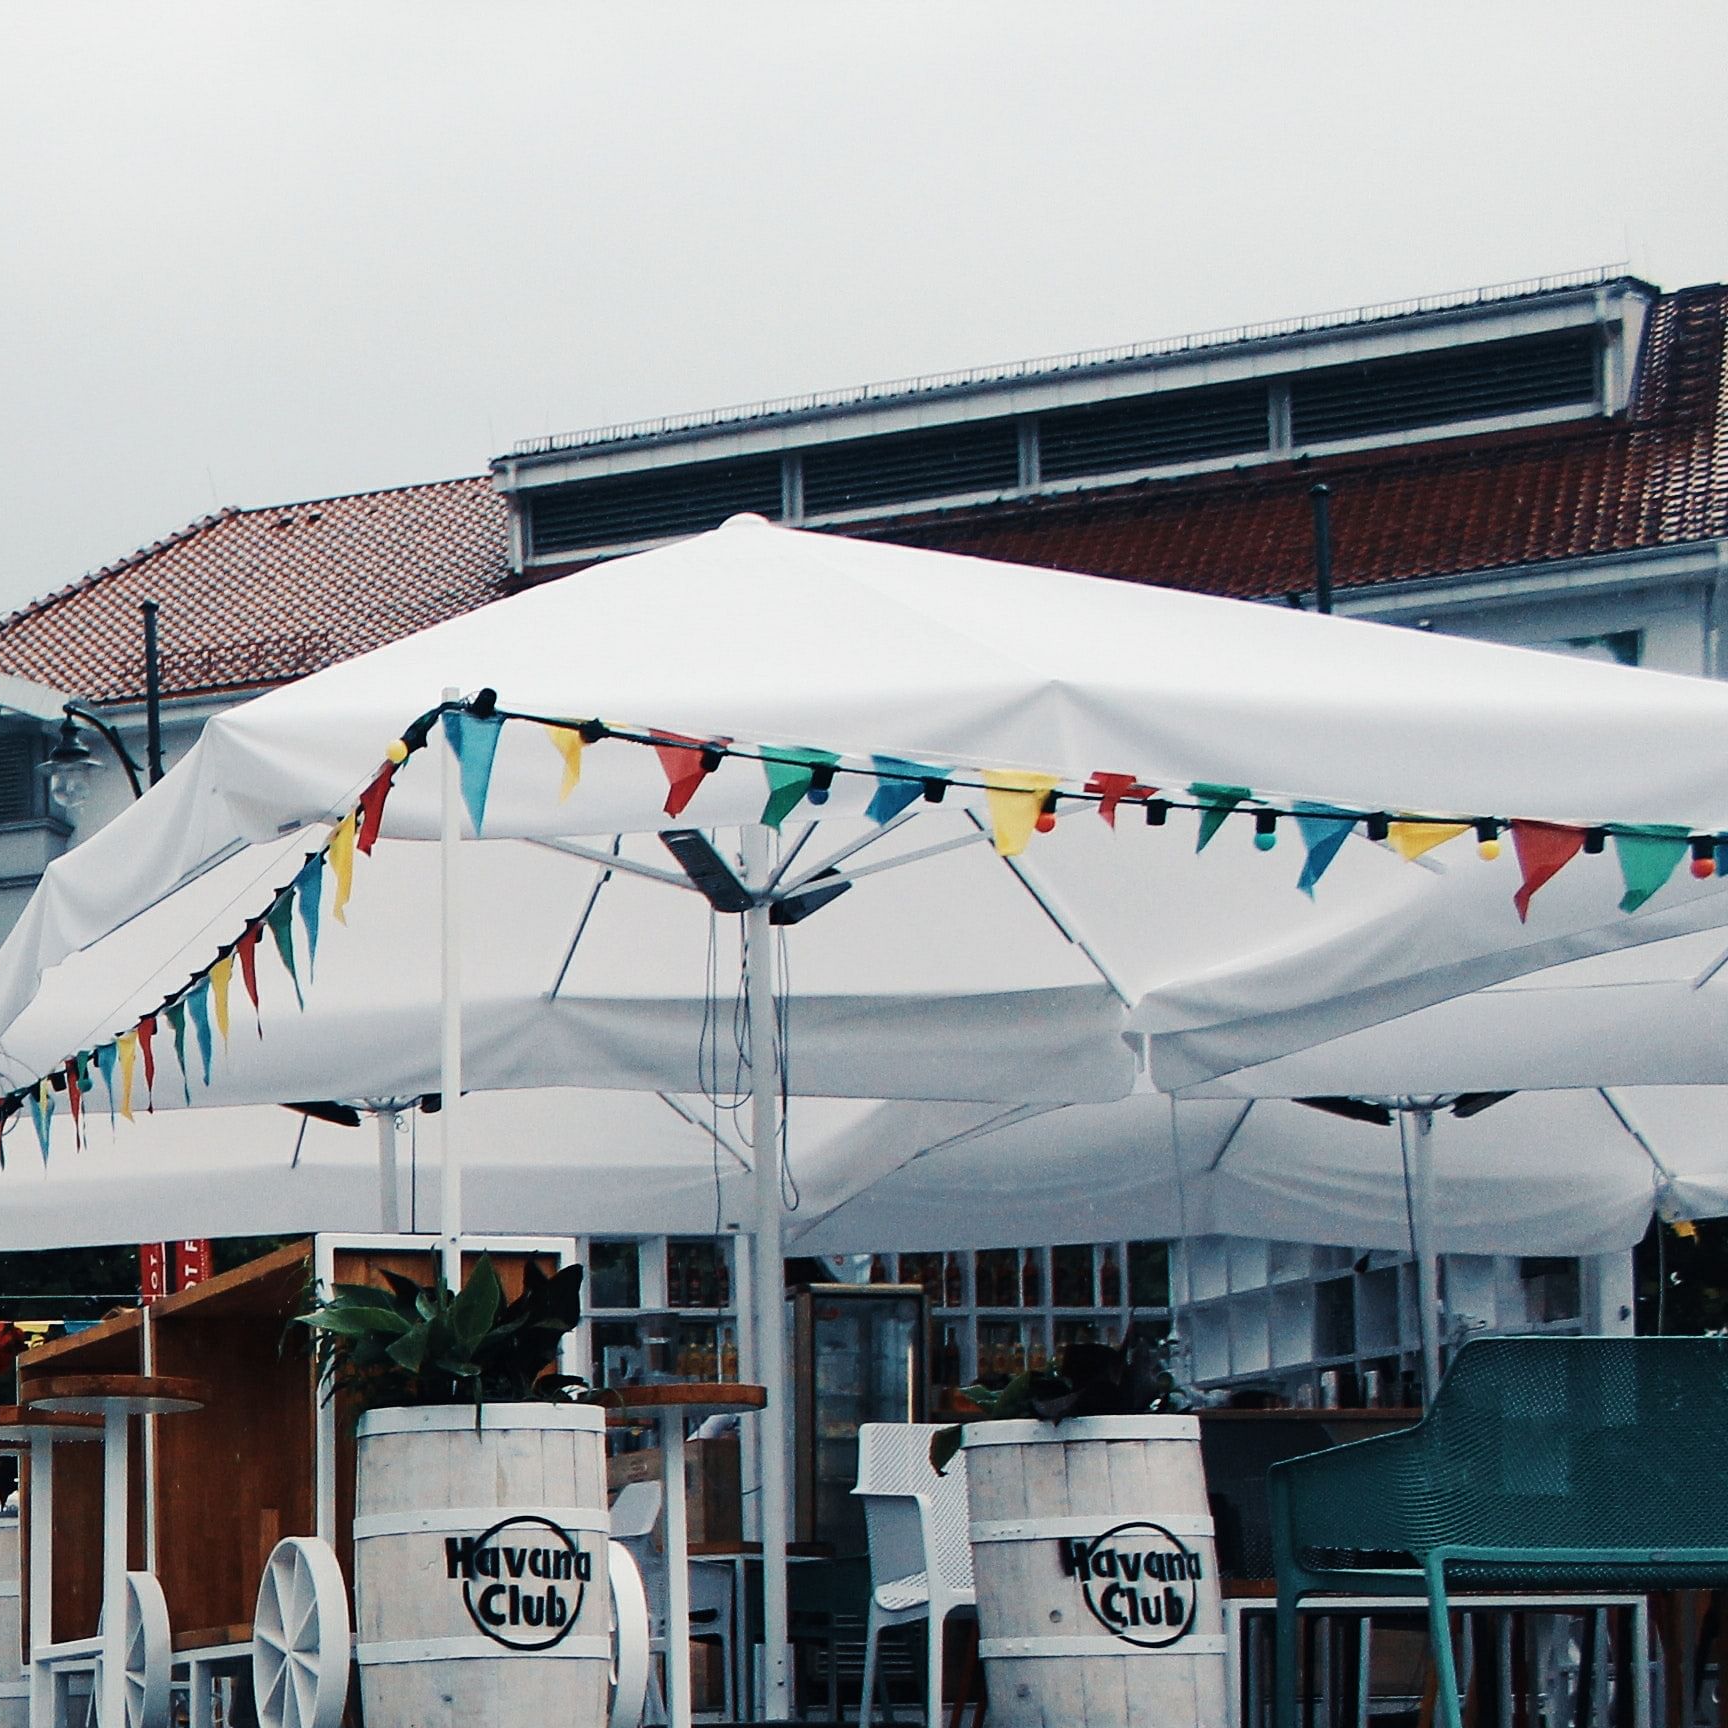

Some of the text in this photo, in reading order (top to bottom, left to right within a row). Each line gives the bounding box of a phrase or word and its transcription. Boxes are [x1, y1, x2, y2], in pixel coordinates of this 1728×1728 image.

[444, 1536, 592, 1582] Havana
[1058, 1538, 1203, 1582] Havana
[478, 1583, 567, 1627] Club
[1100, 1581, 1184, 1628] Club
